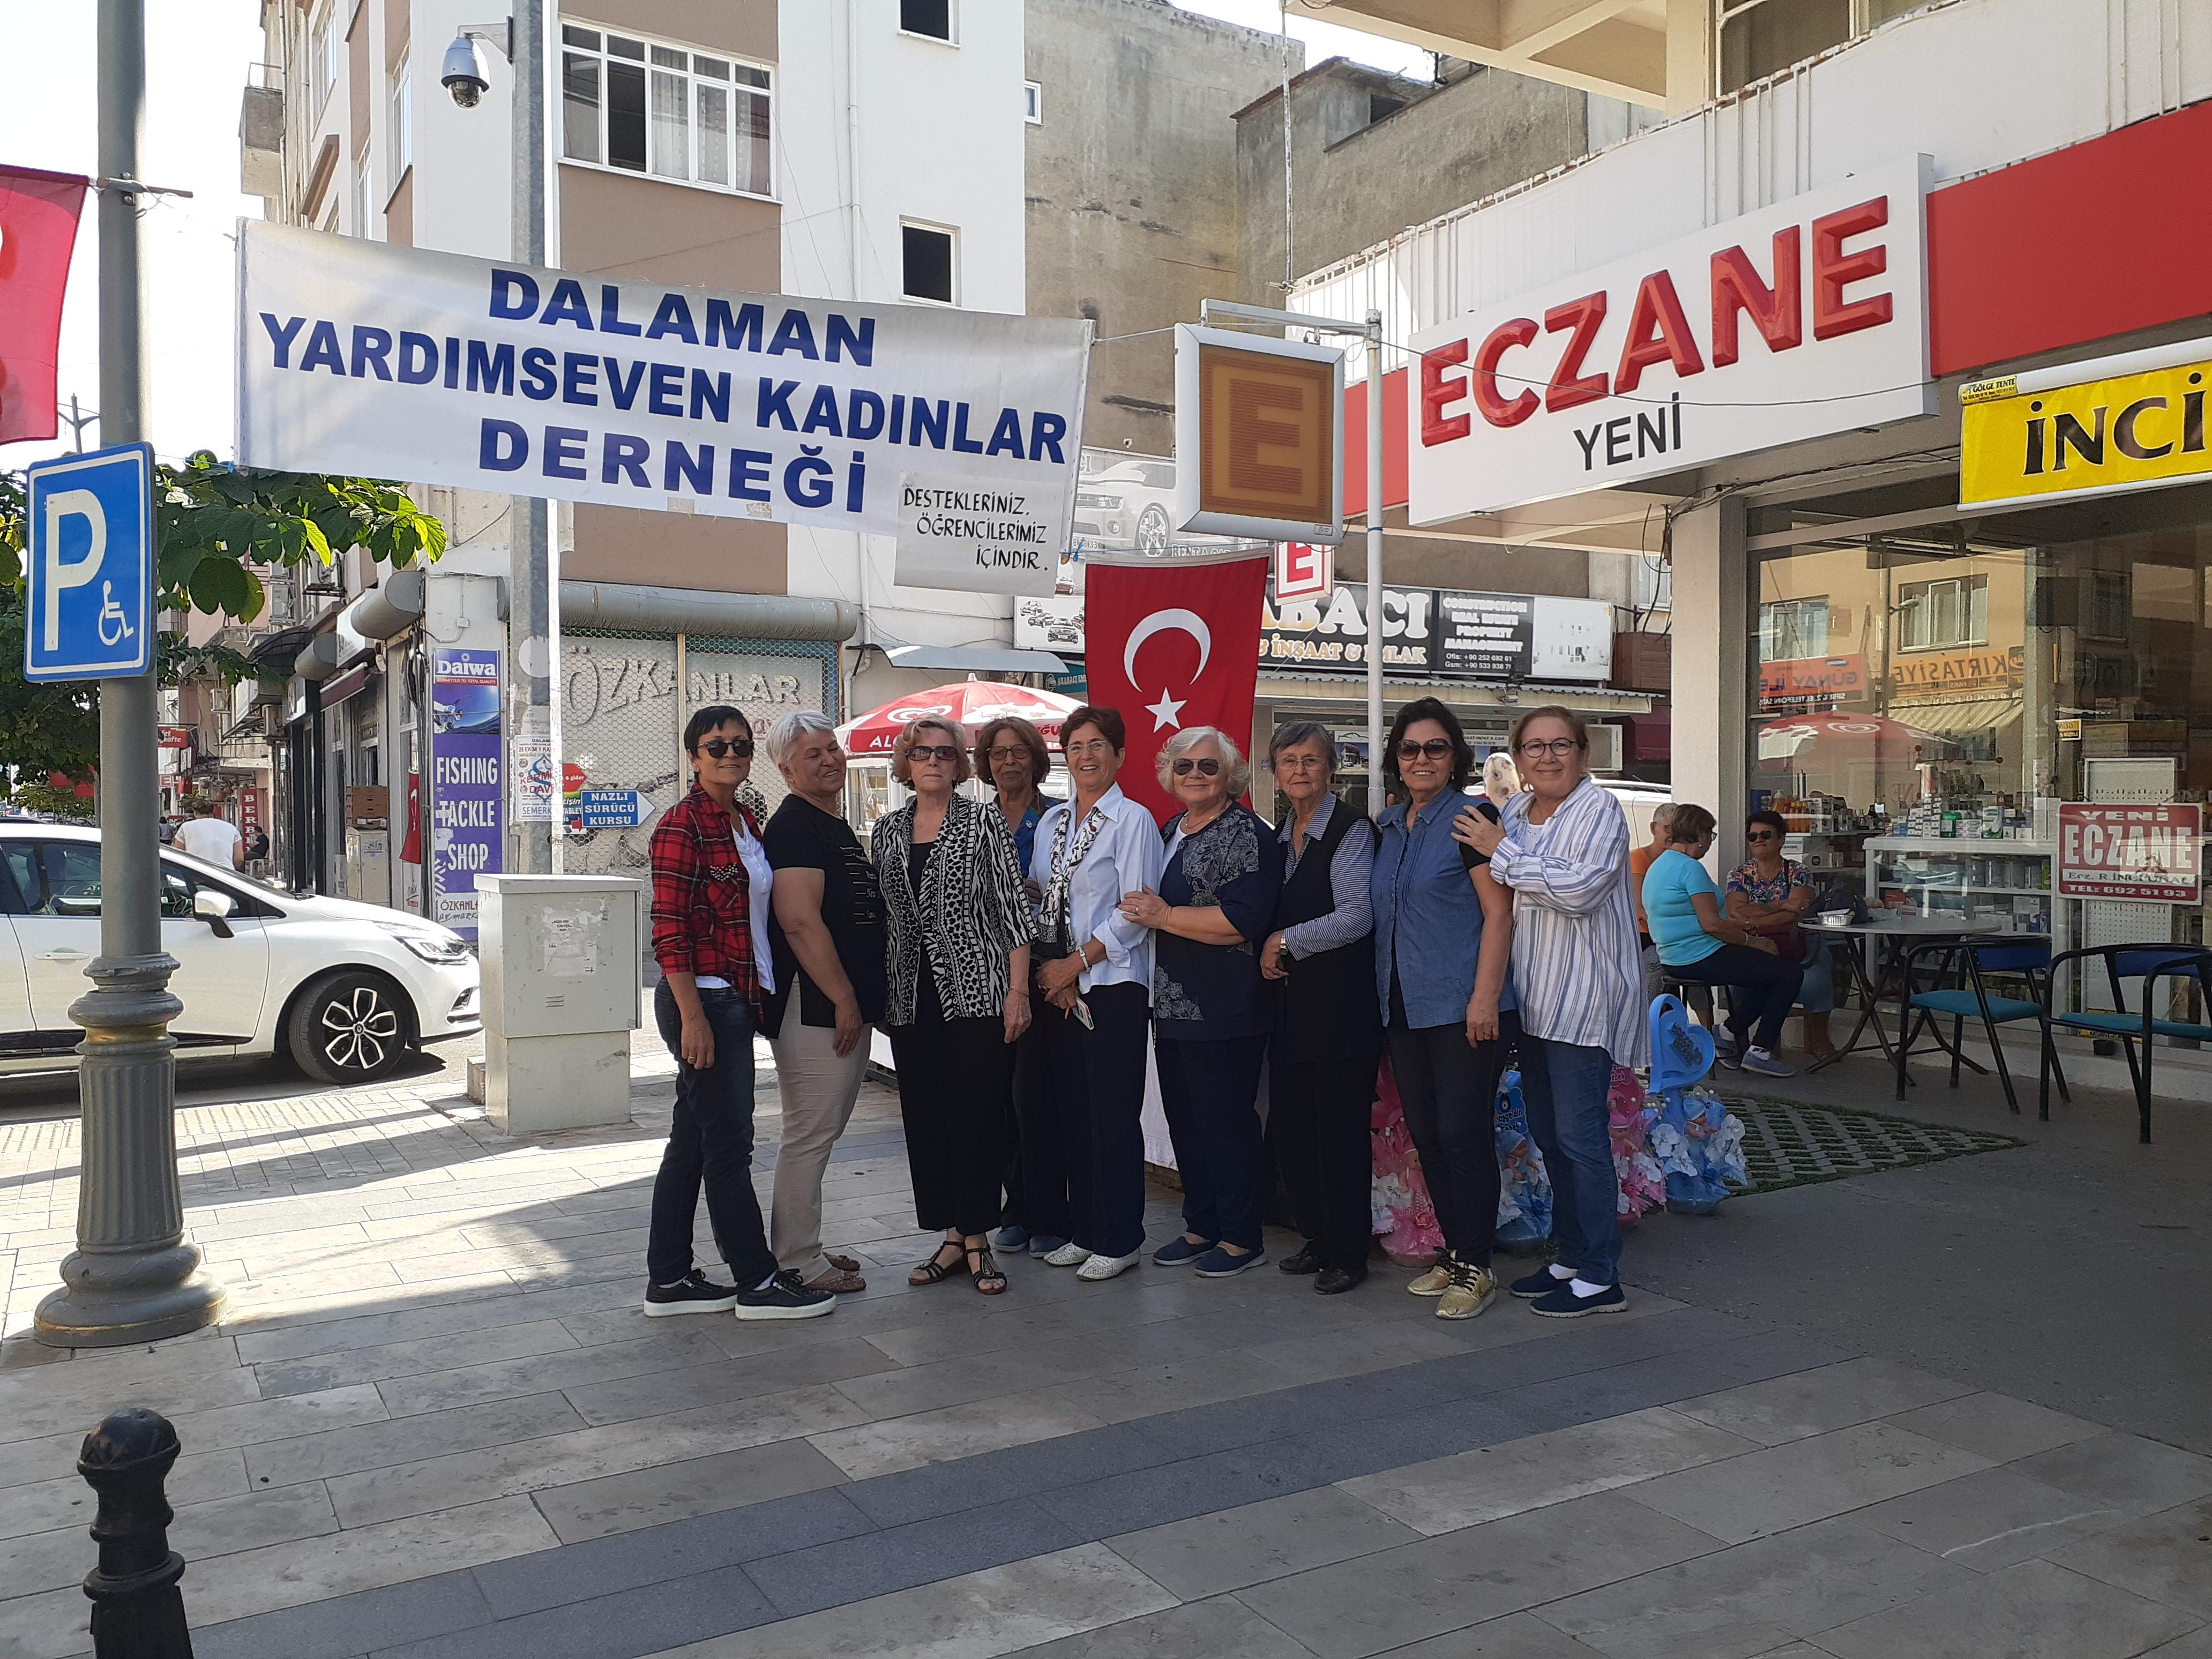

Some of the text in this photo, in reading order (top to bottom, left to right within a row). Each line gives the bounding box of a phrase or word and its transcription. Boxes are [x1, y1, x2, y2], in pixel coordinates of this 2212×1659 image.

[489, 268, 875, 367] DALAMAN
[1421, 195, 1893, 447] ECZANE
[259, 312, 1066, 464] YARDIMSEVEN KADINLAR
[1972, 378, 2015, 392] GÖLGE TENTE
[1230, 378, 1303, 494] E
[1574, 392, 1682, 470] YENİ
[2021, 371, 2207, 476] İNCİ
[479, 418, 865, 513] DERNEĞİ
[917, 512, 1047, 543] ÖĞRENCİLERİMİZ
[44, 489, 107, 651] P
[1271, 633, 1343, 662] İNŞAAT
[437, 653, 496, 676] Daiwa
[569, 646, 800, 726] ÖZKANLAR
[437, 757, 498, 784] FISHING
[585, 802, 635, 813] SÜRÜCÜ
[591, 793, 629, 801] NAZLI
[439, 800, 495, 827] TACKLE
[589, 816, 632, 825] KURSU
[2080, 806, 2169, 821] YENİ
[447, 843, 489, 871] SHOP
[2065, 824, 2192, 869] ECZANE
[2068, 884, 2187, 898] TEL: 692 51 93
